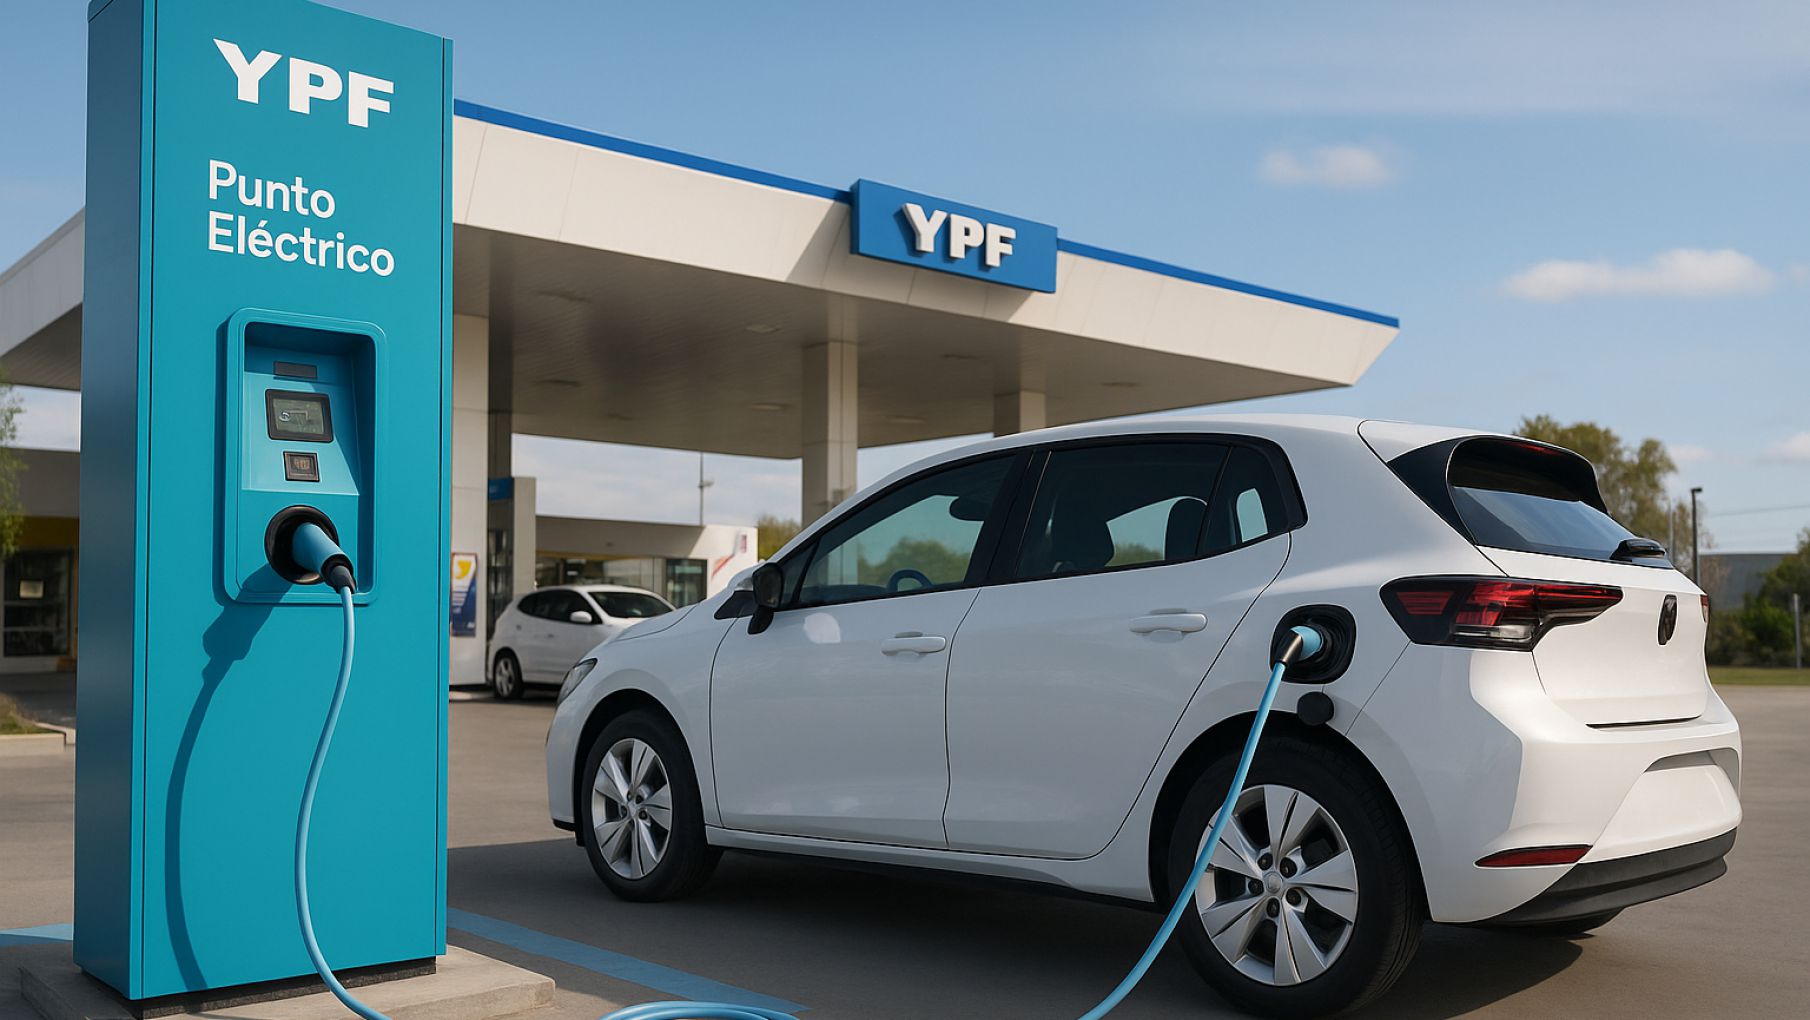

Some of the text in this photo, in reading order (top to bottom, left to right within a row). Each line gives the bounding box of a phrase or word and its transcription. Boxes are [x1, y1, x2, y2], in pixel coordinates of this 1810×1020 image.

[213, 38, 394, 128] YPF
[209, 159, 336, 219] Punto
[208, 210, 395, 276] Eléctrico
[903, 203, 1016, 267] YPF
